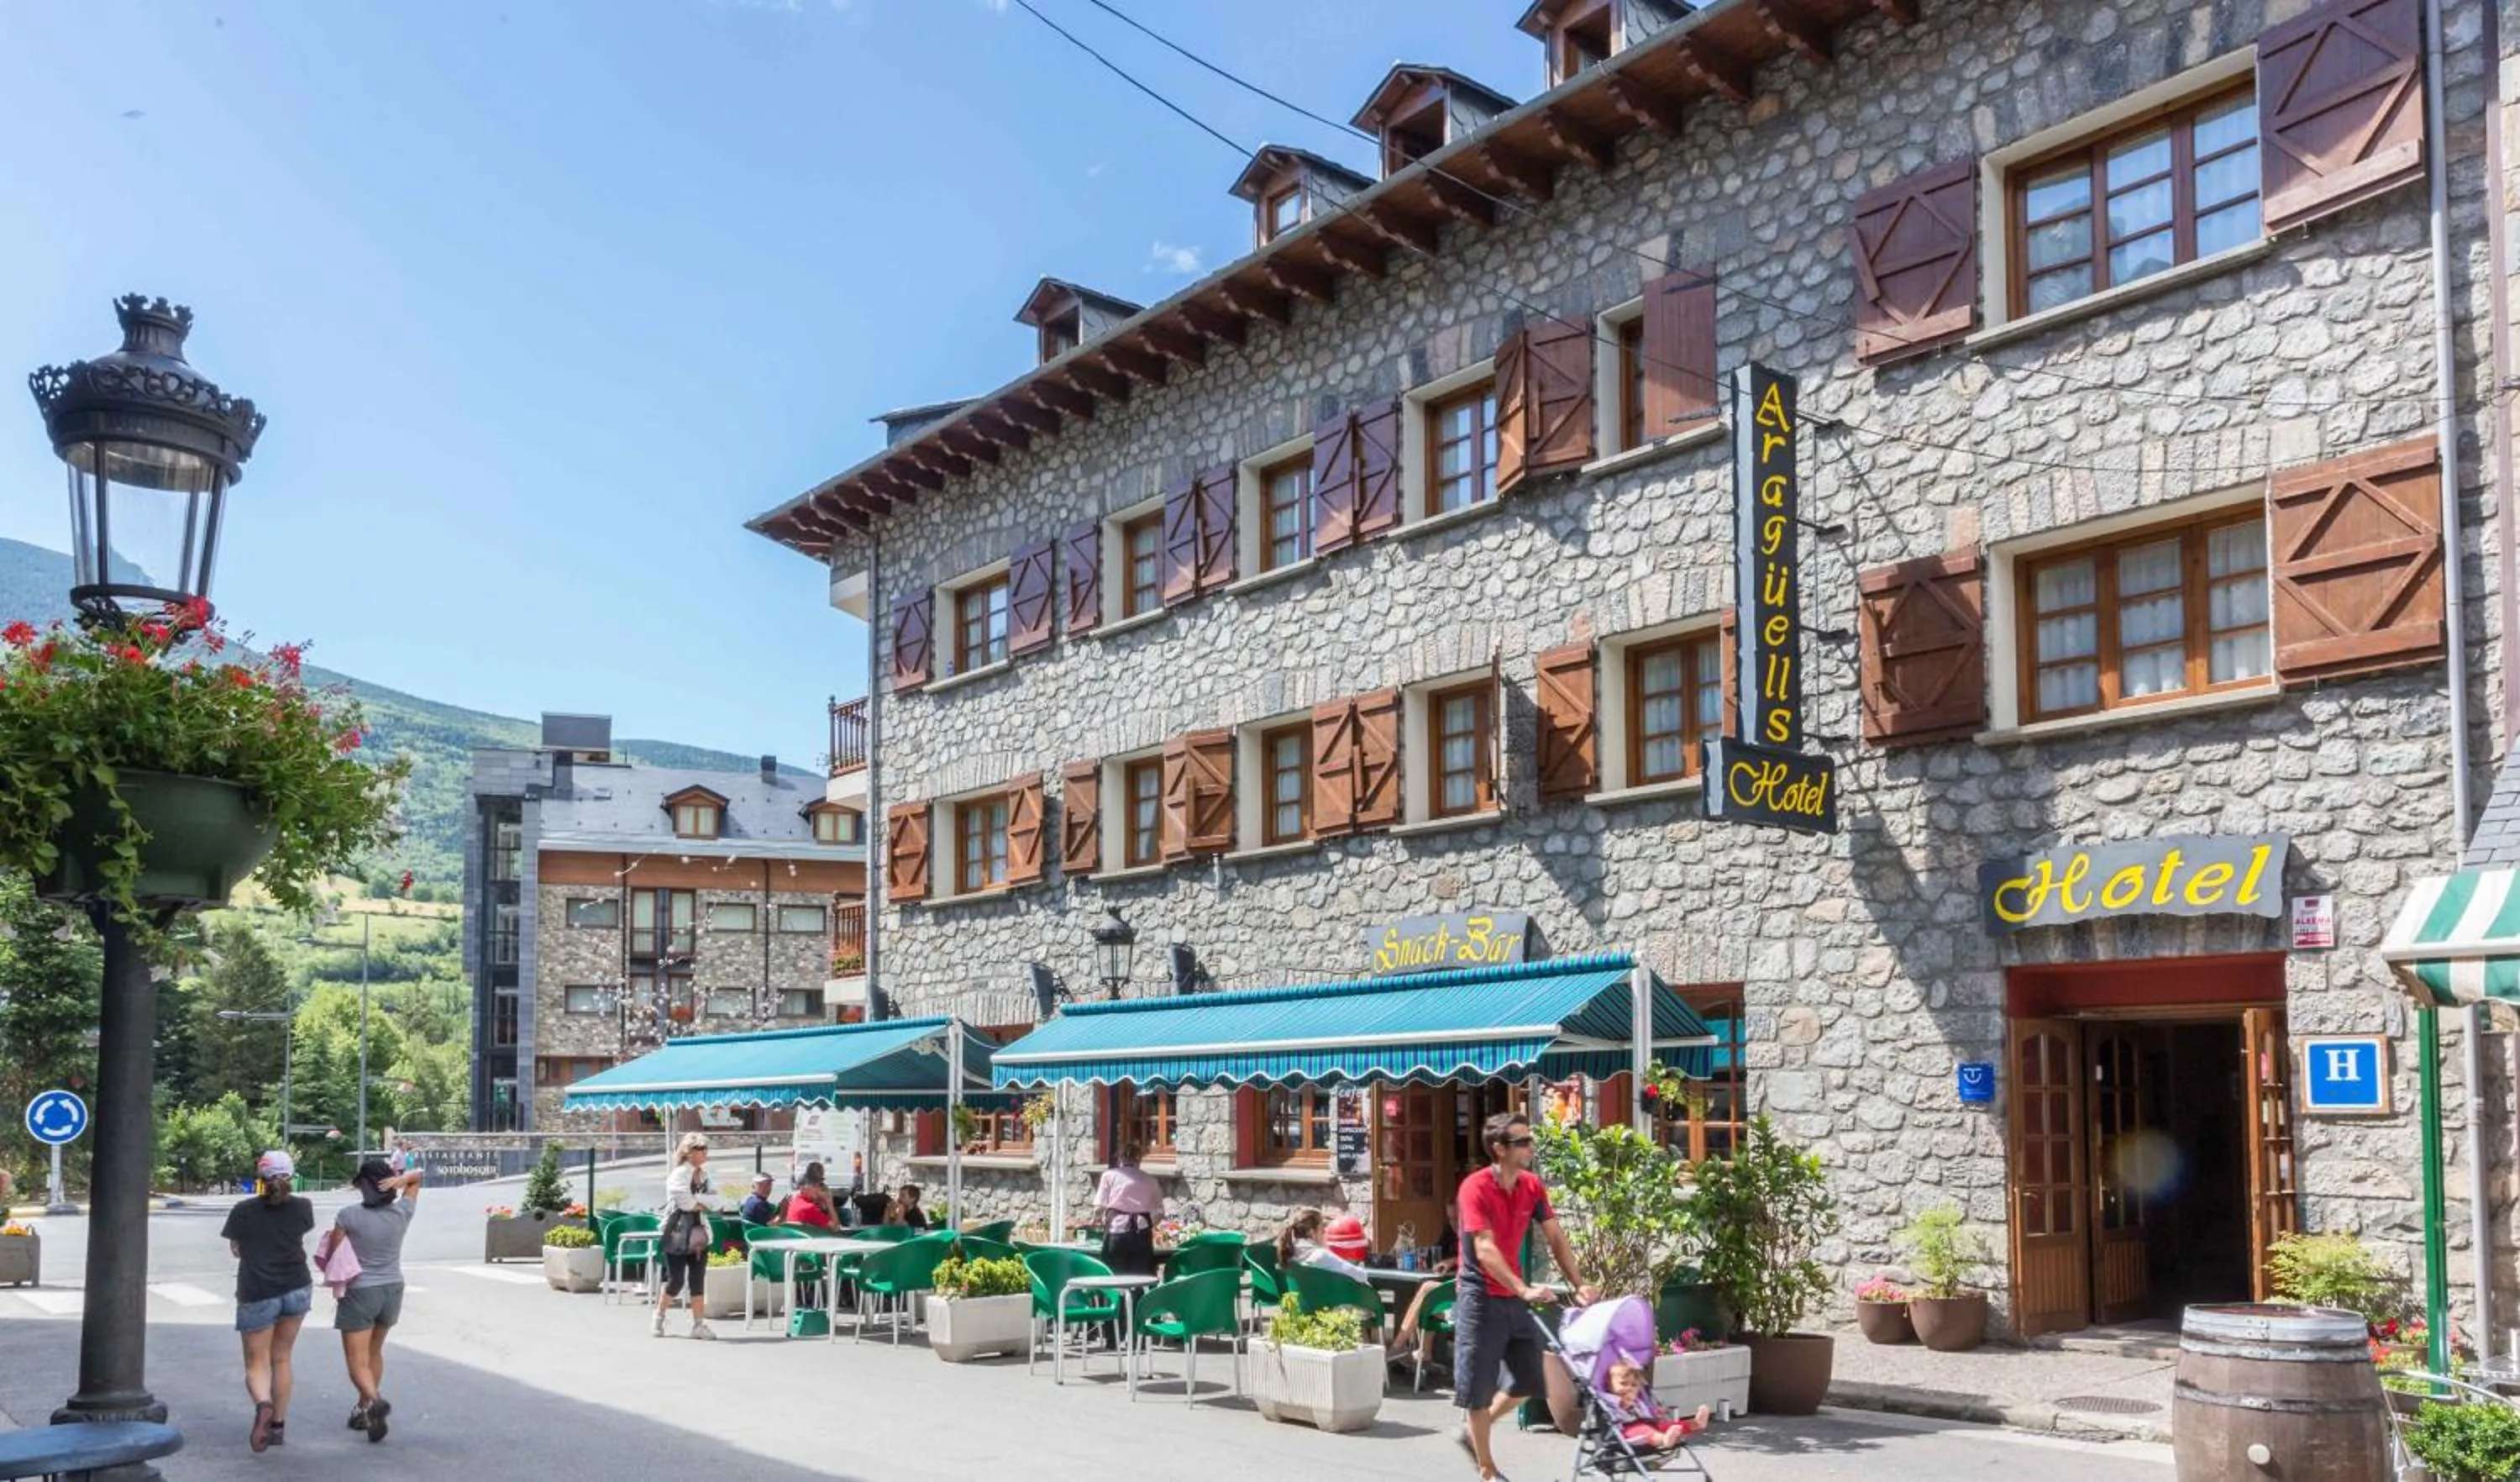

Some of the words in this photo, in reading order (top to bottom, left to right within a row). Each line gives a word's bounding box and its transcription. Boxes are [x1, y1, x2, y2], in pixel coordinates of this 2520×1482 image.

[1756, 382, 1792, 744] Aragüells
[1729, 759, 1829, 817] Hotel
[1993, 843, 2273, 922] Hotel
[1373, 915, 1522, 974] Snack-Bar
[2324, 1049, 2362, 1082] H
